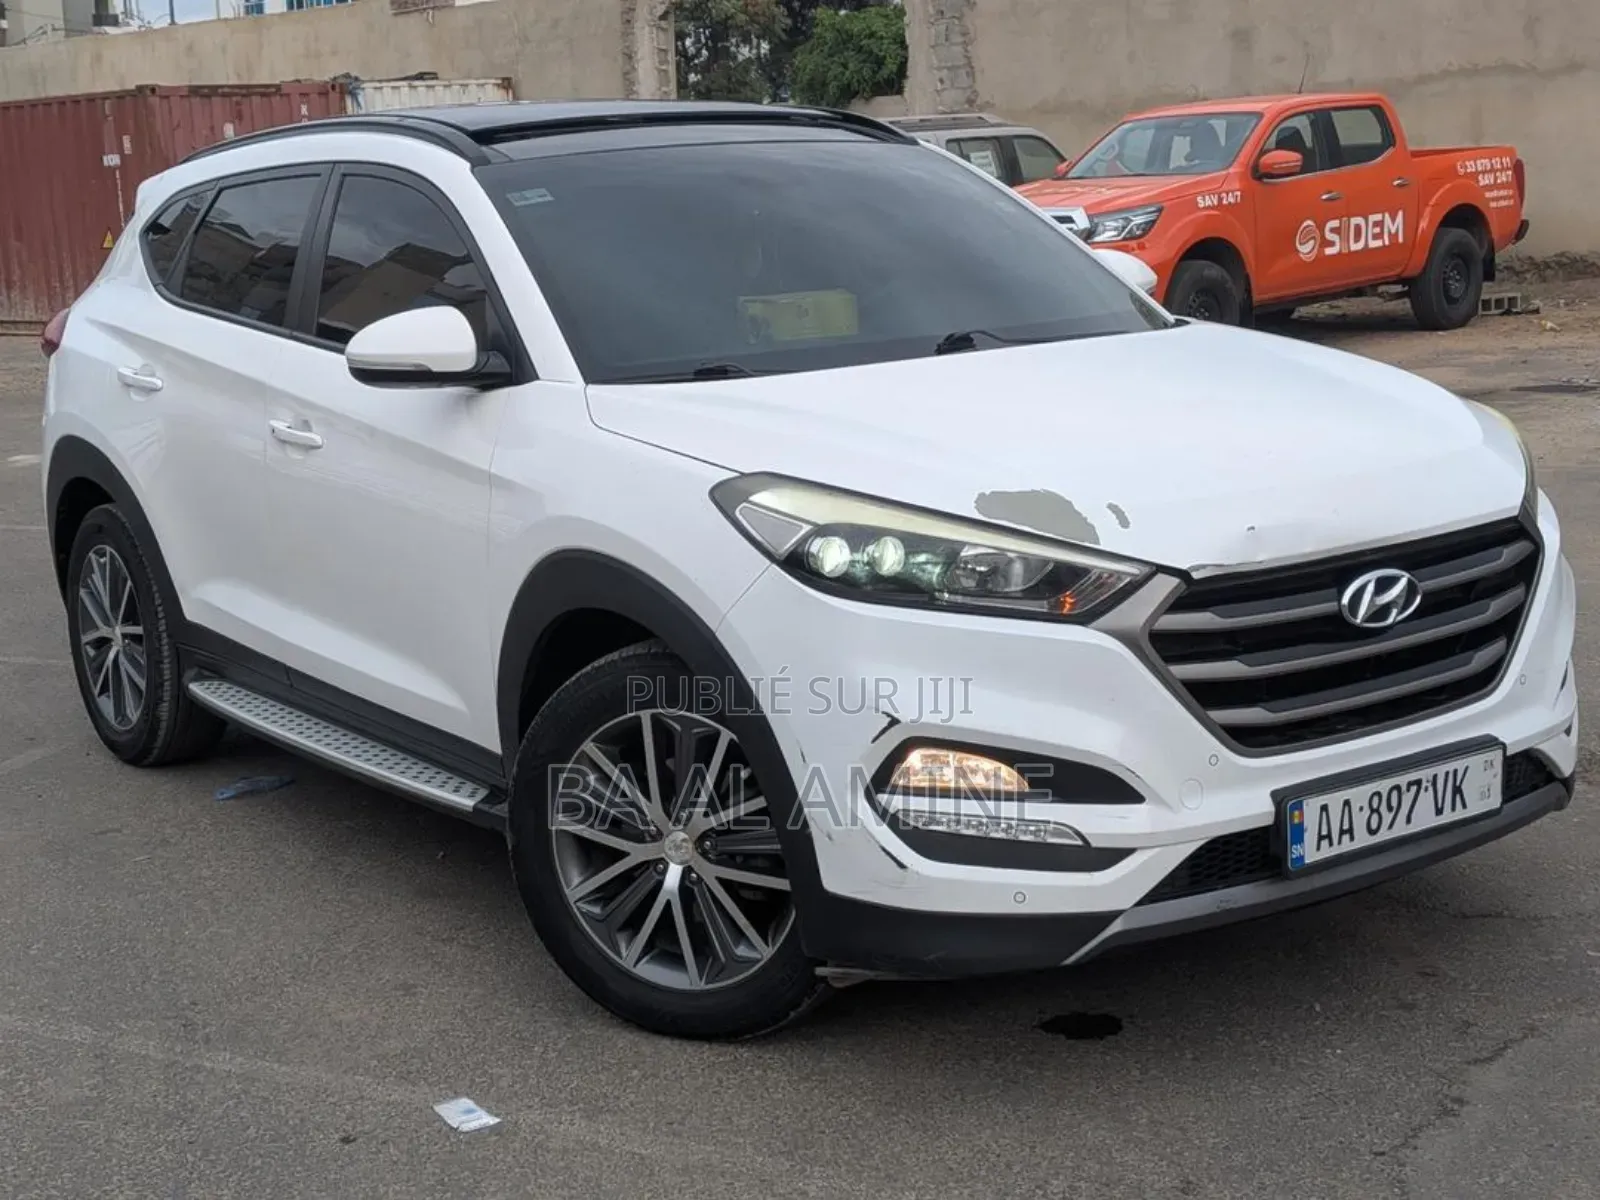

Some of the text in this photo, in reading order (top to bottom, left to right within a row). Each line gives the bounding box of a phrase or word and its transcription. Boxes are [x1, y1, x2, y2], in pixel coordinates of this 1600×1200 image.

[1478, 172, 1495, 187] SAV
[1196, 190, 1241, 209] SAV 24/7
[1323, 208, 1404, 256] SIDEM
[1291, 842, 1305, 859] SN
